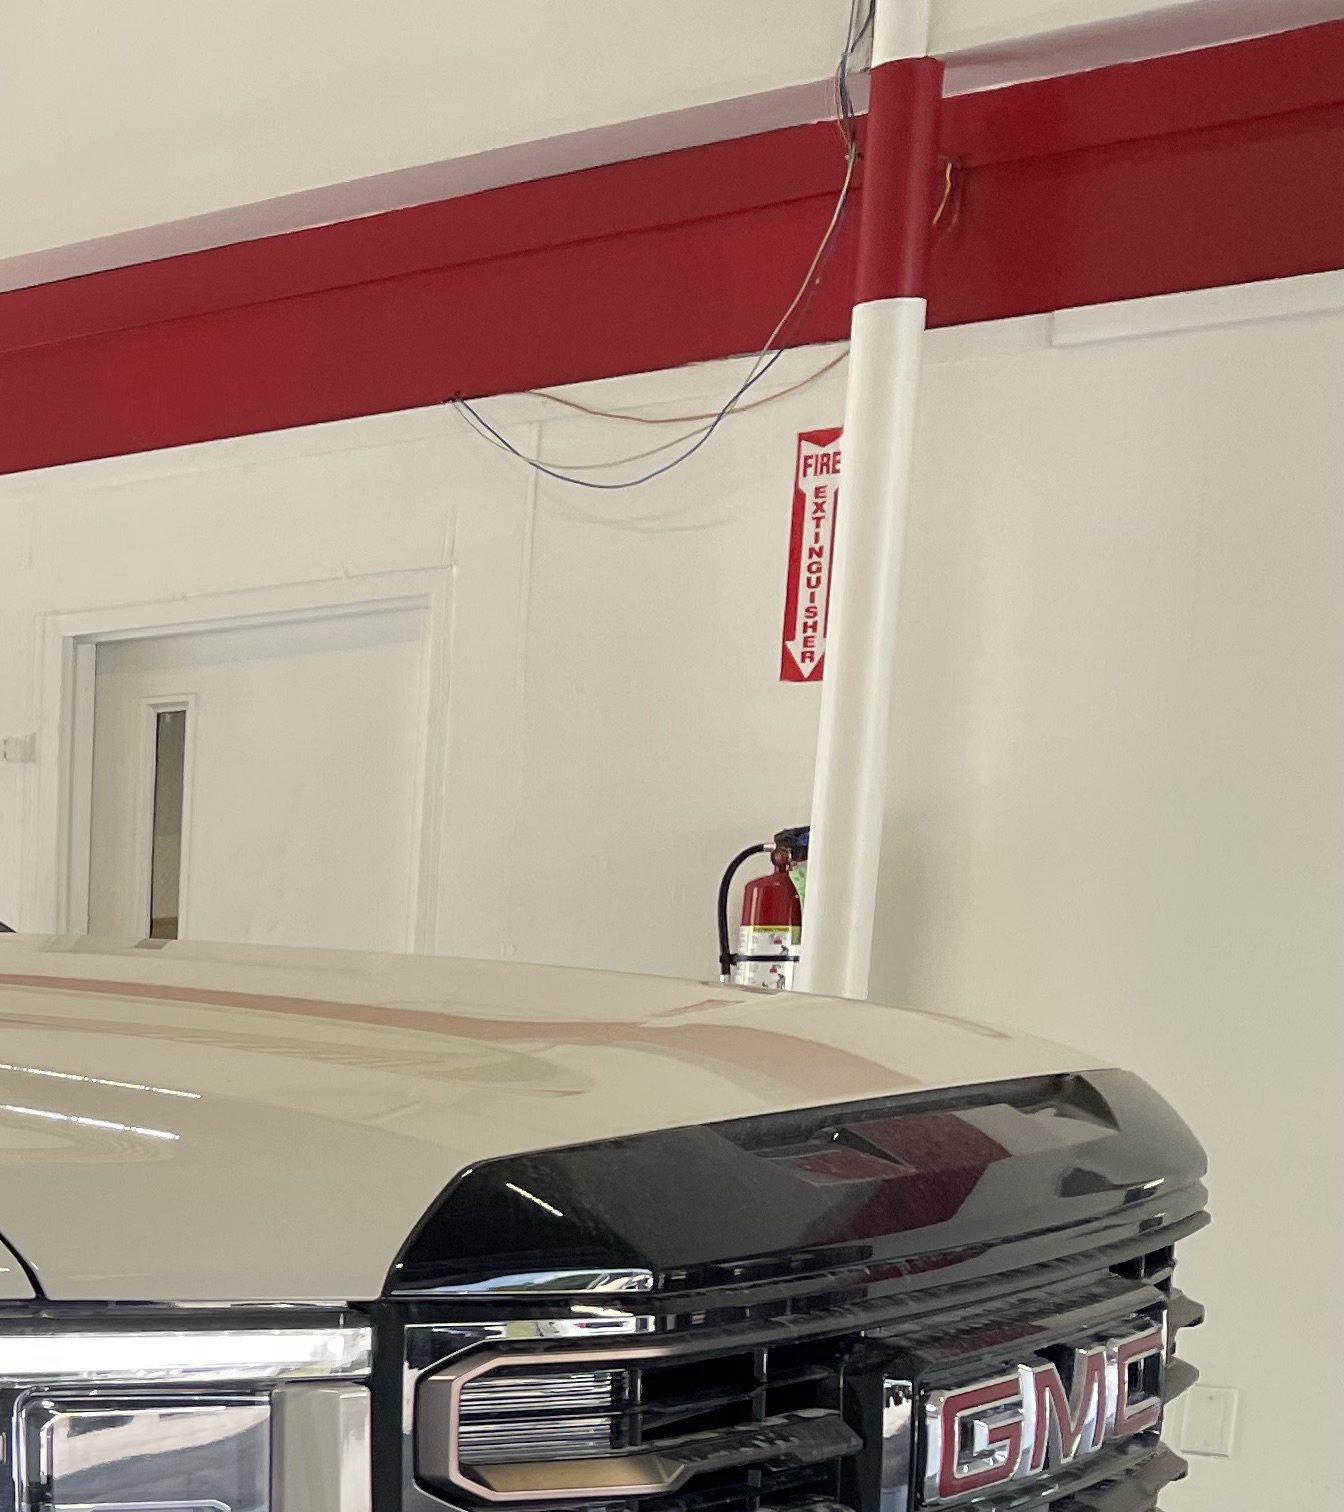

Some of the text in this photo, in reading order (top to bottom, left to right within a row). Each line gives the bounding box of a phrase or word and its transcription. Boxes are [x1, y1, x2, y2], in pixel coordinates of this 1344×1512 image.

[802, 451, 841, 477] FIRE
[800, 485, 828, 663] EXTINGUISHER
[923, 1320, 1165, 1503] GMC
